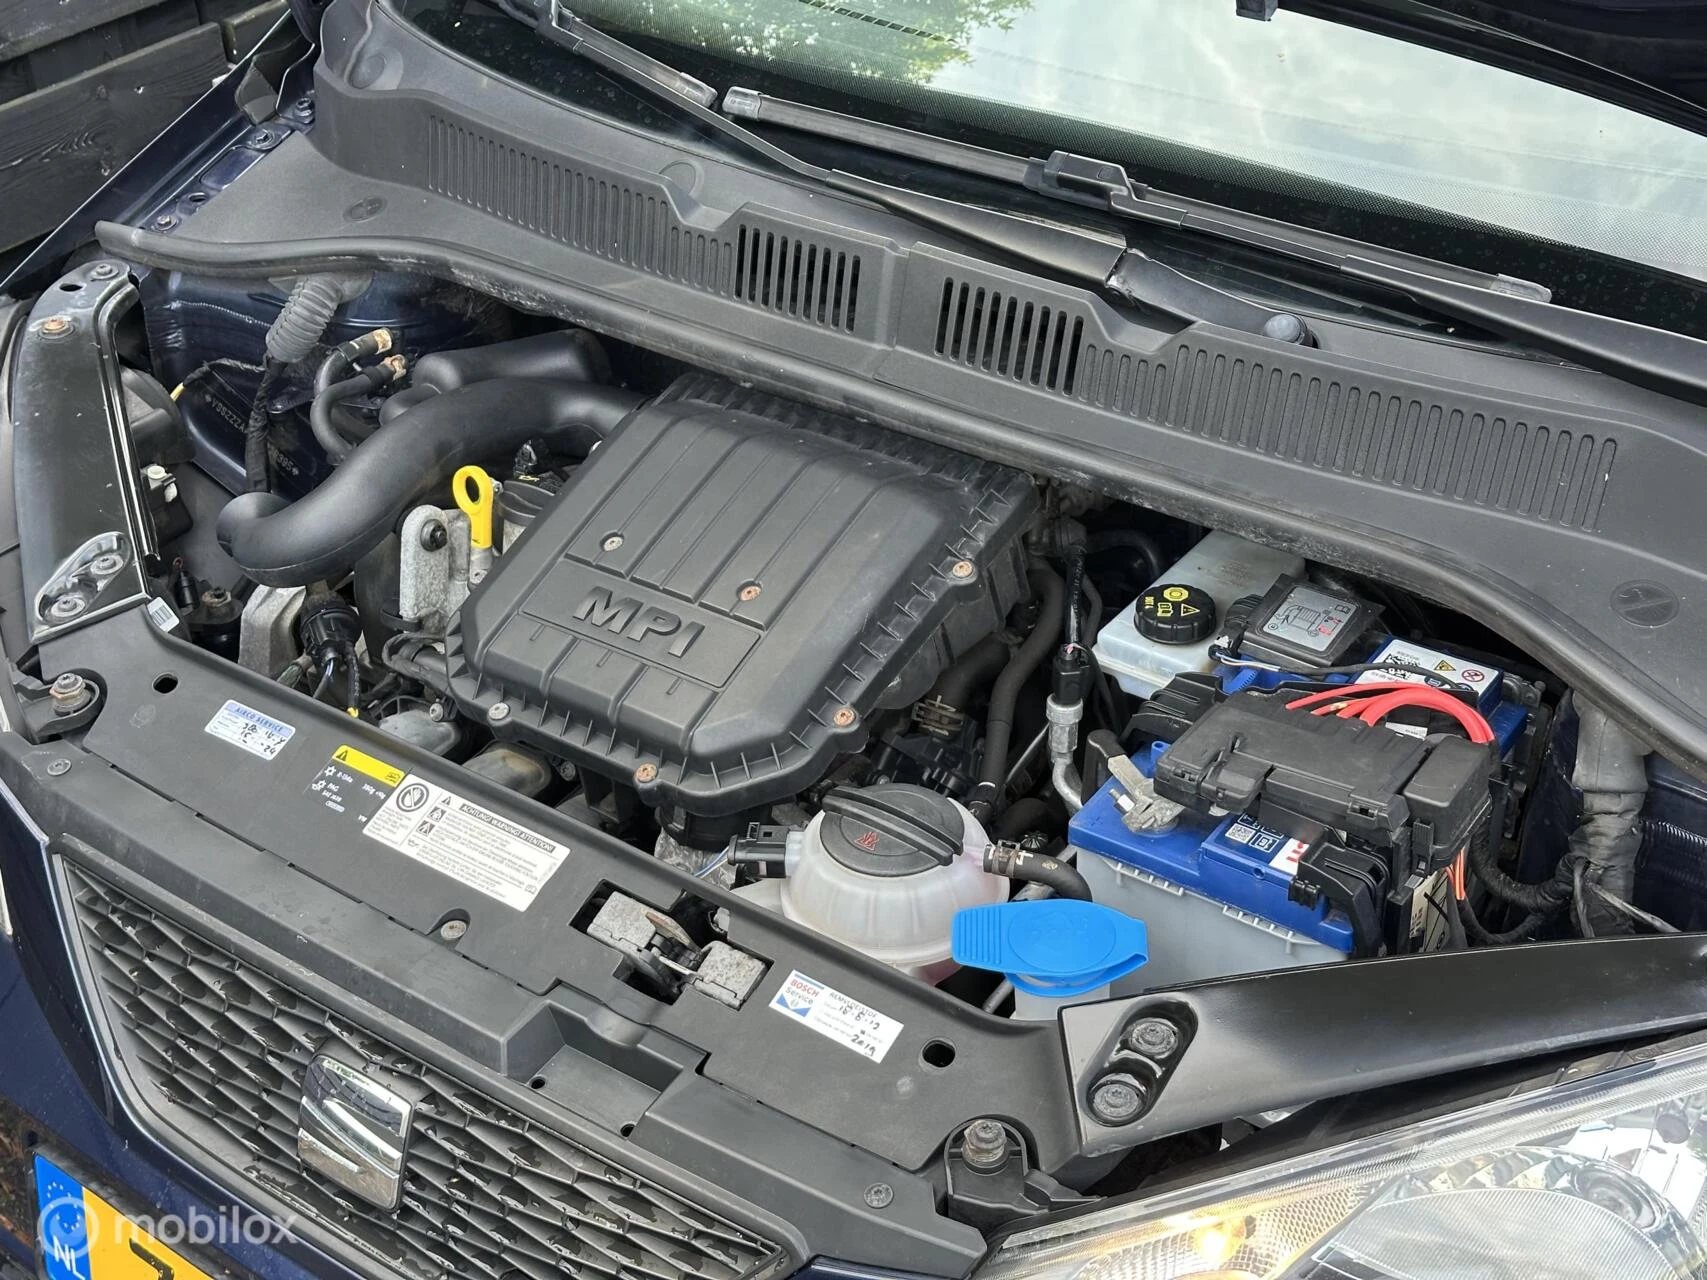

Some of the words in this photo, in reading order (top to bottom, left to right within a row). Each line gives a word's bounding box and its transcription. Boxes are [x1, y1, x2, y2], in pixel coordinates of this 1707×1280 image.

[572, 586, 706, 659] MPI
[235, 707, 256, 720] AIRCO
[256, 716, 284, 732] SERVICE
[461, 804, 492, 823] ACHTUNG!
[491, 817, 520, 836] WARNING!
[520, 831, 555, 852] ATTENTION!
[785, 986, 814, 1006] Service
[790, 979, 820, 998] BOSCH
[52, 1234, 86, 1280] NL
